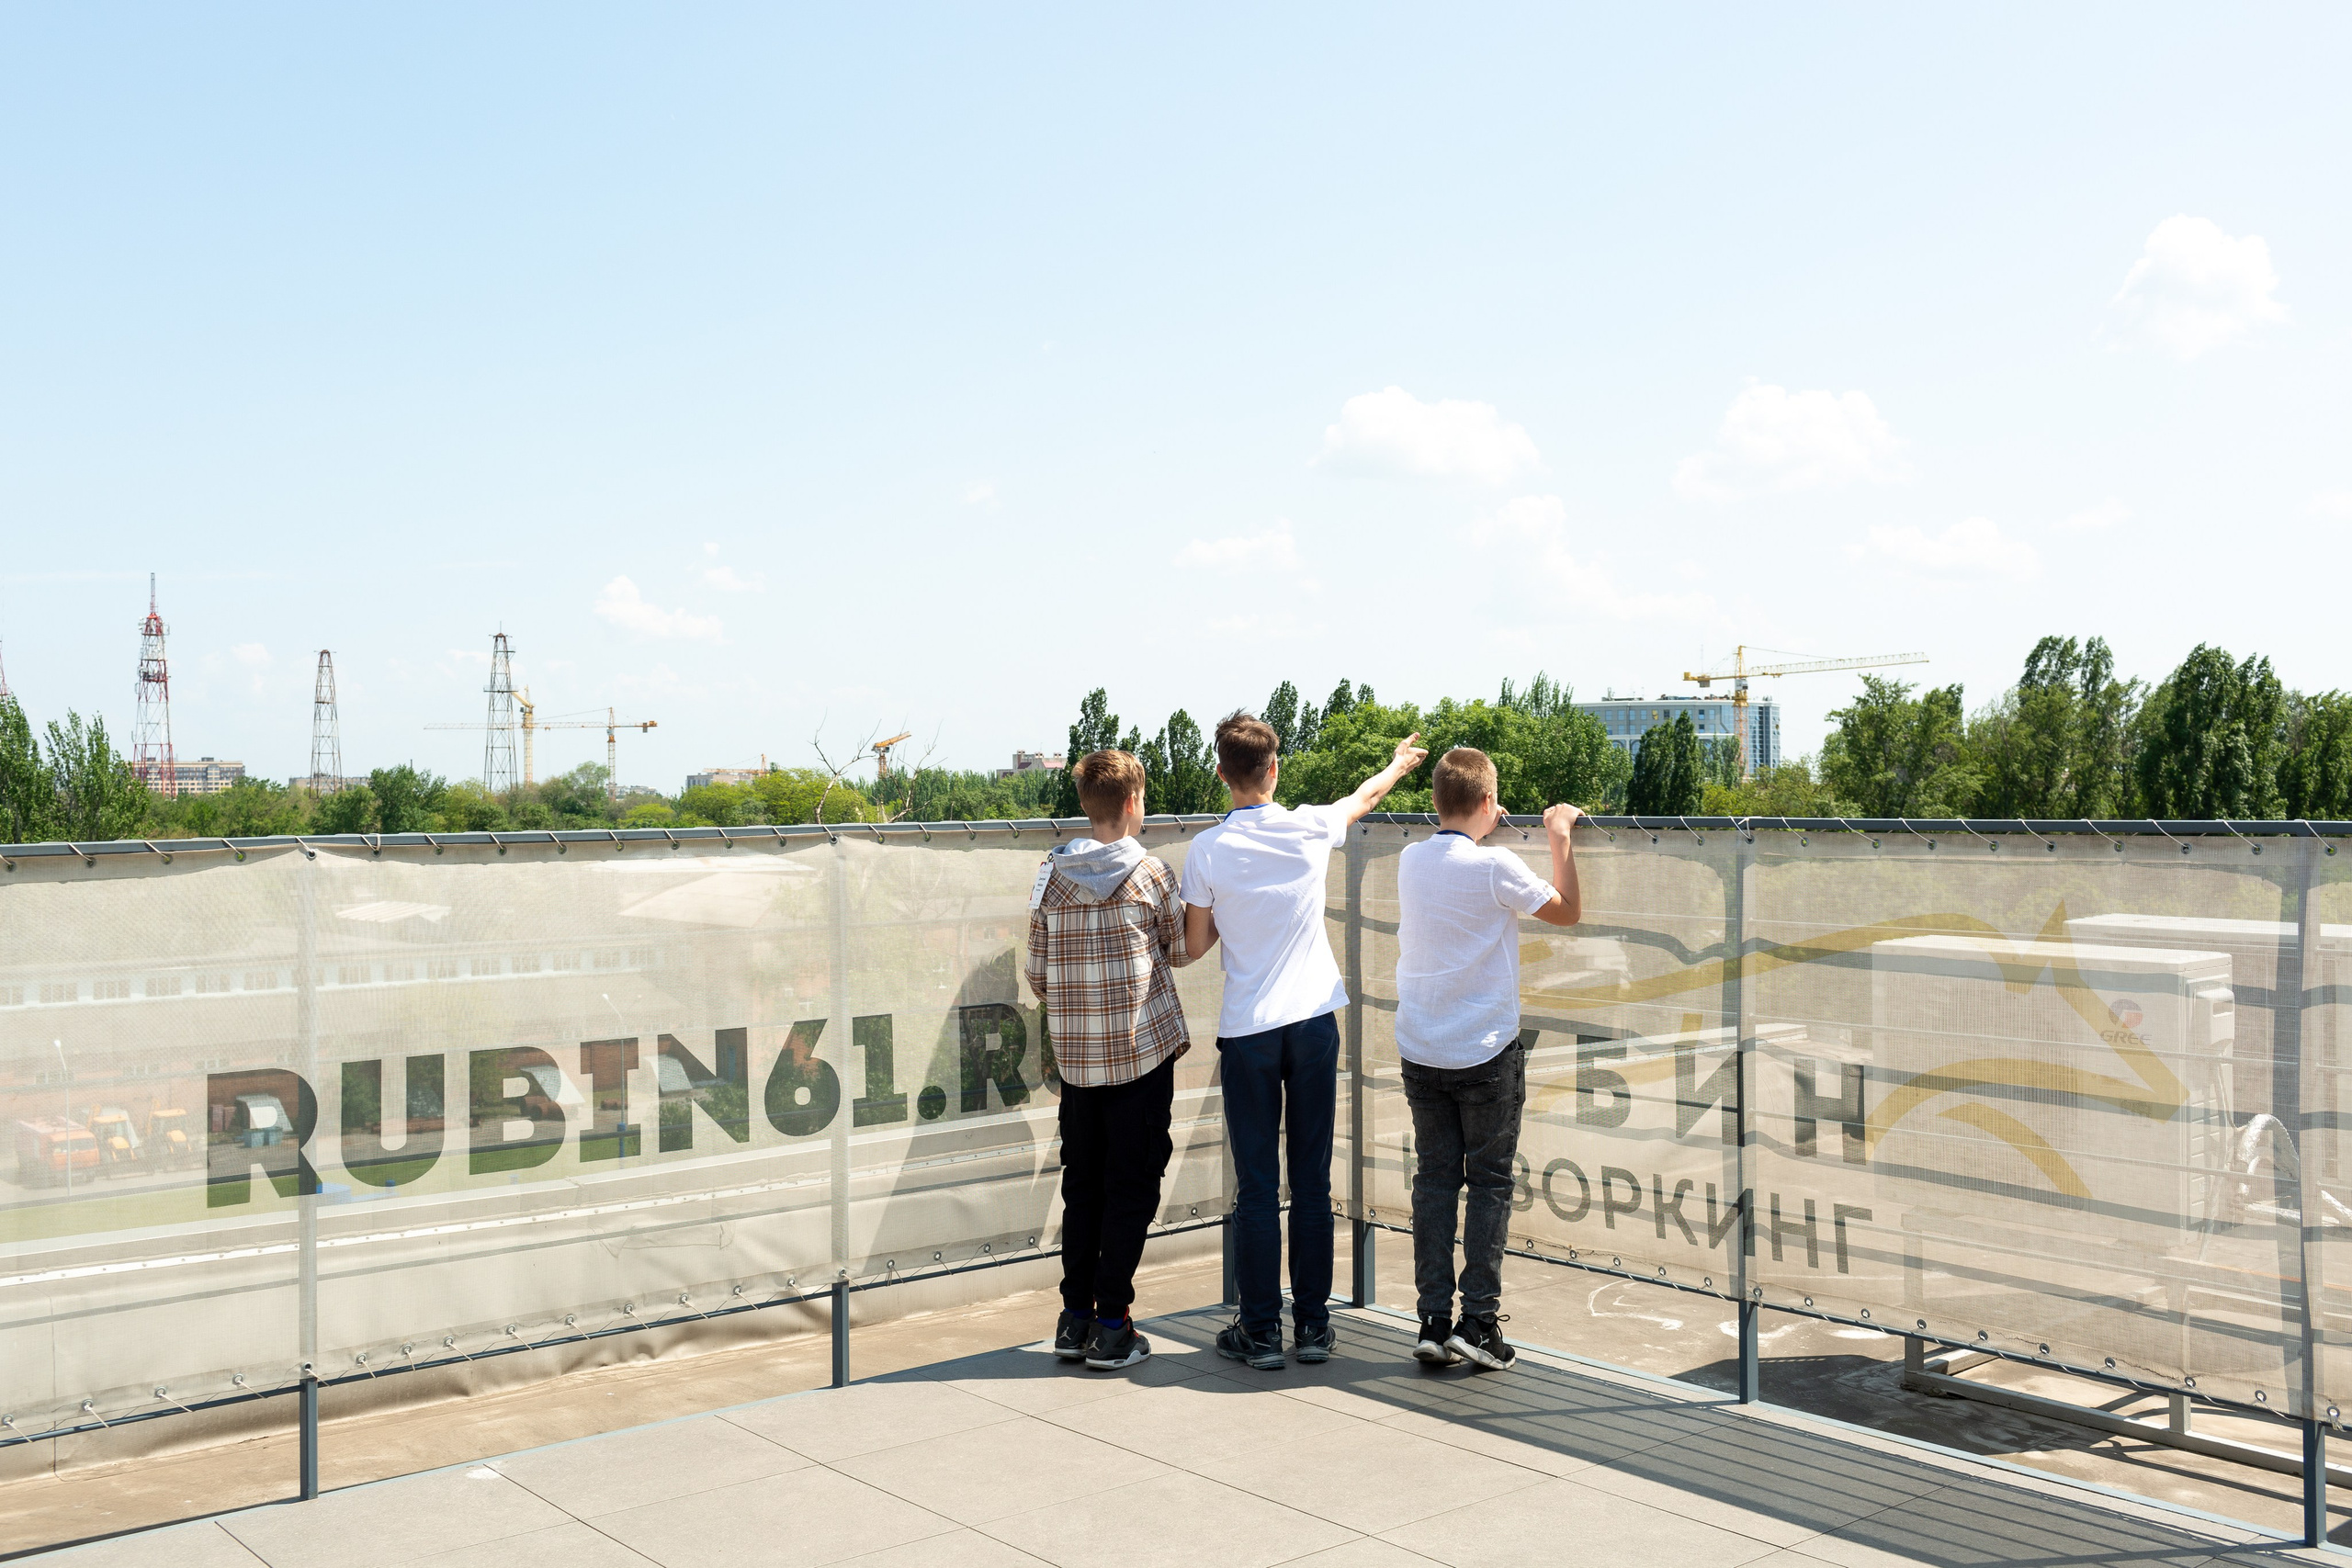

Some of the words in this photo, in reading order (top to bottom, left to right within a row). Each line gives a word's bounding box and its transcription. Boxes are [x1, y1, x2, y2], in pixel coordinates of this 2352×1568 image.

[207, 1002, 1062, 1209] RUBIN61.R
[1519, 1028, 1867, 1166] БИН
[2099, 1029, 2153, 1046] GREE
[1402, 1131, 1872, 1274] ВОРКИНГ
